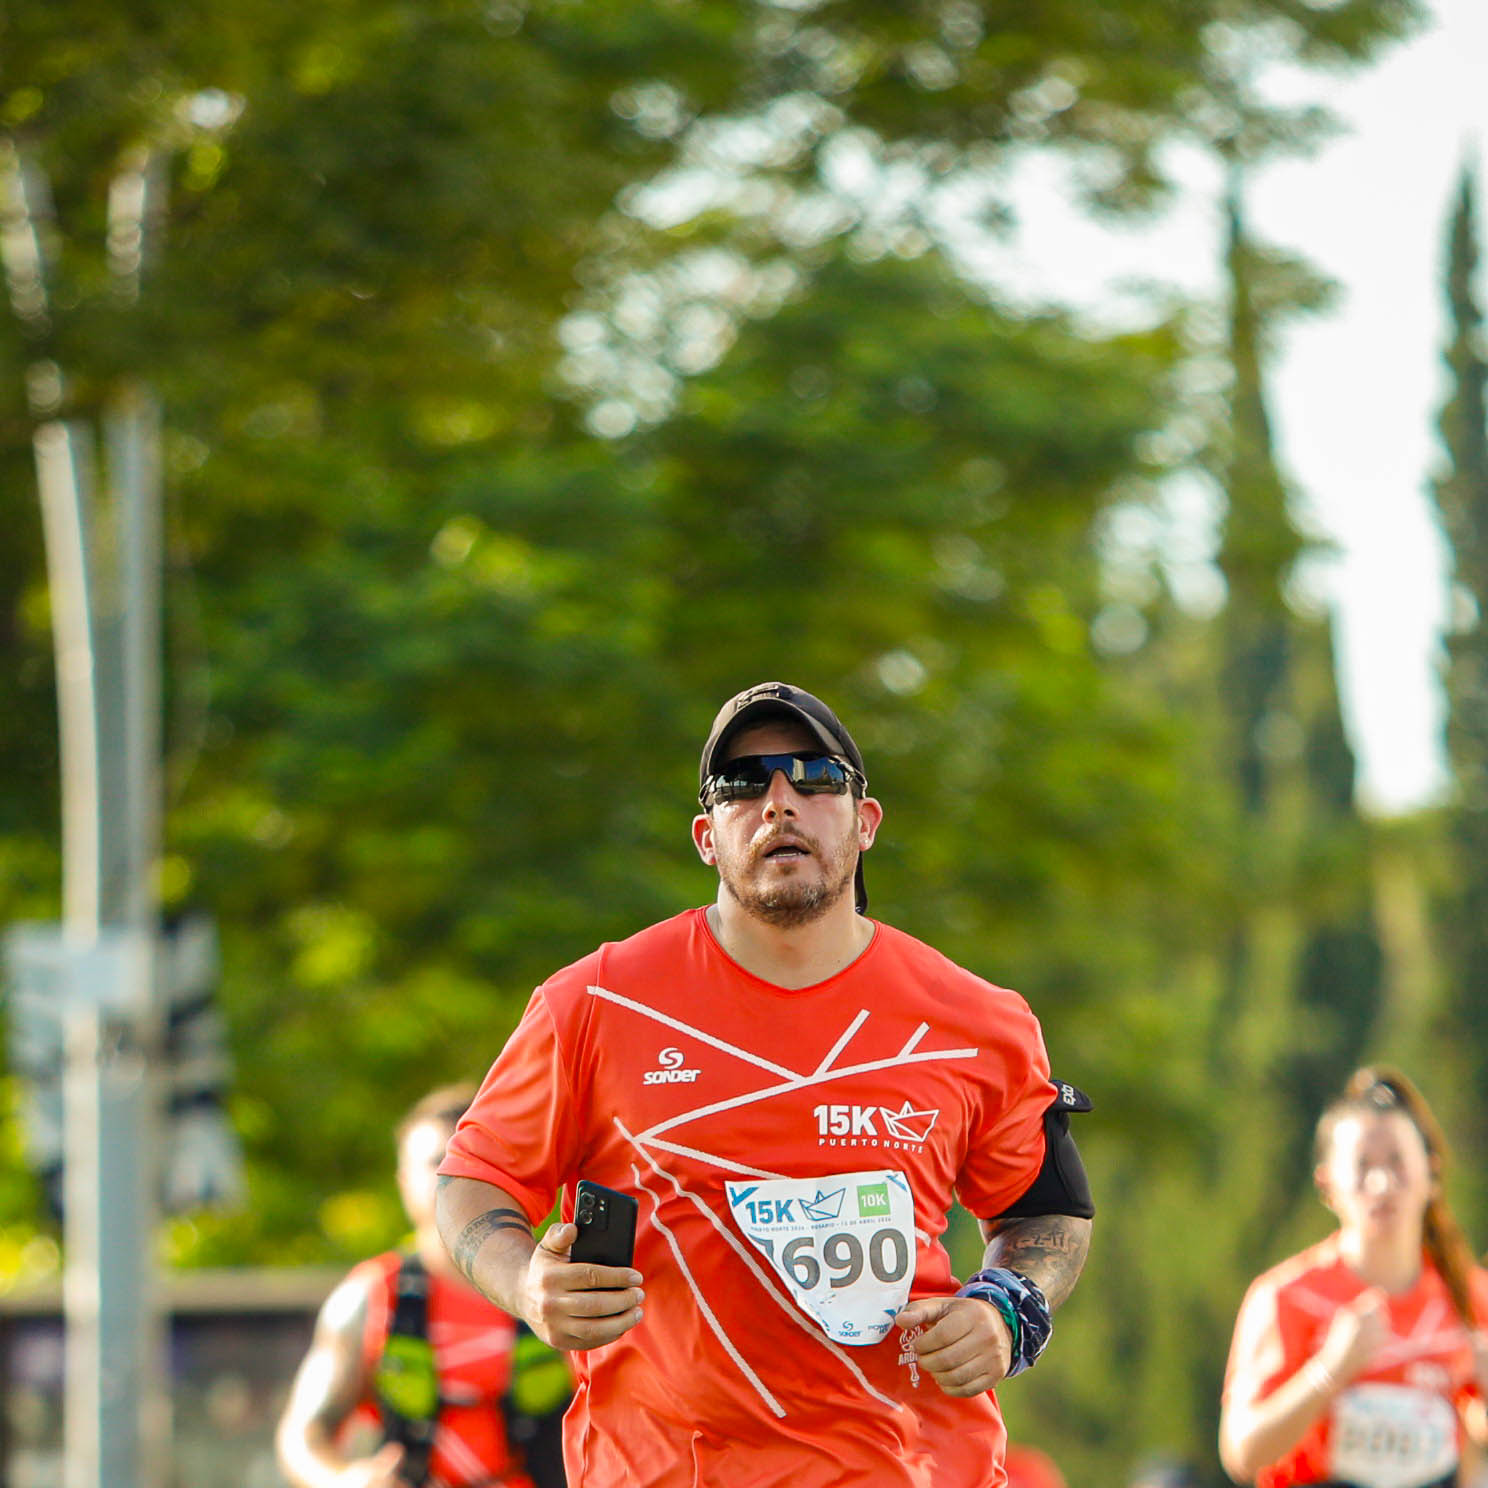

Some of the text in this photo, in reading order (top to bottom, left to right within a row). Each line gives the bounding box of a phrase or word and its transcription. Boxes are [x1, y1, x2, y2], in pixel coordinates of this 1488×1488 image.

[813, 1105, 878, 1136] 15K
[818, 1138, 924, 1154] PUERTO NORTE
[861, 1194, 887, 1208] 10K
[745, 1199, 796, 1225] 15K
